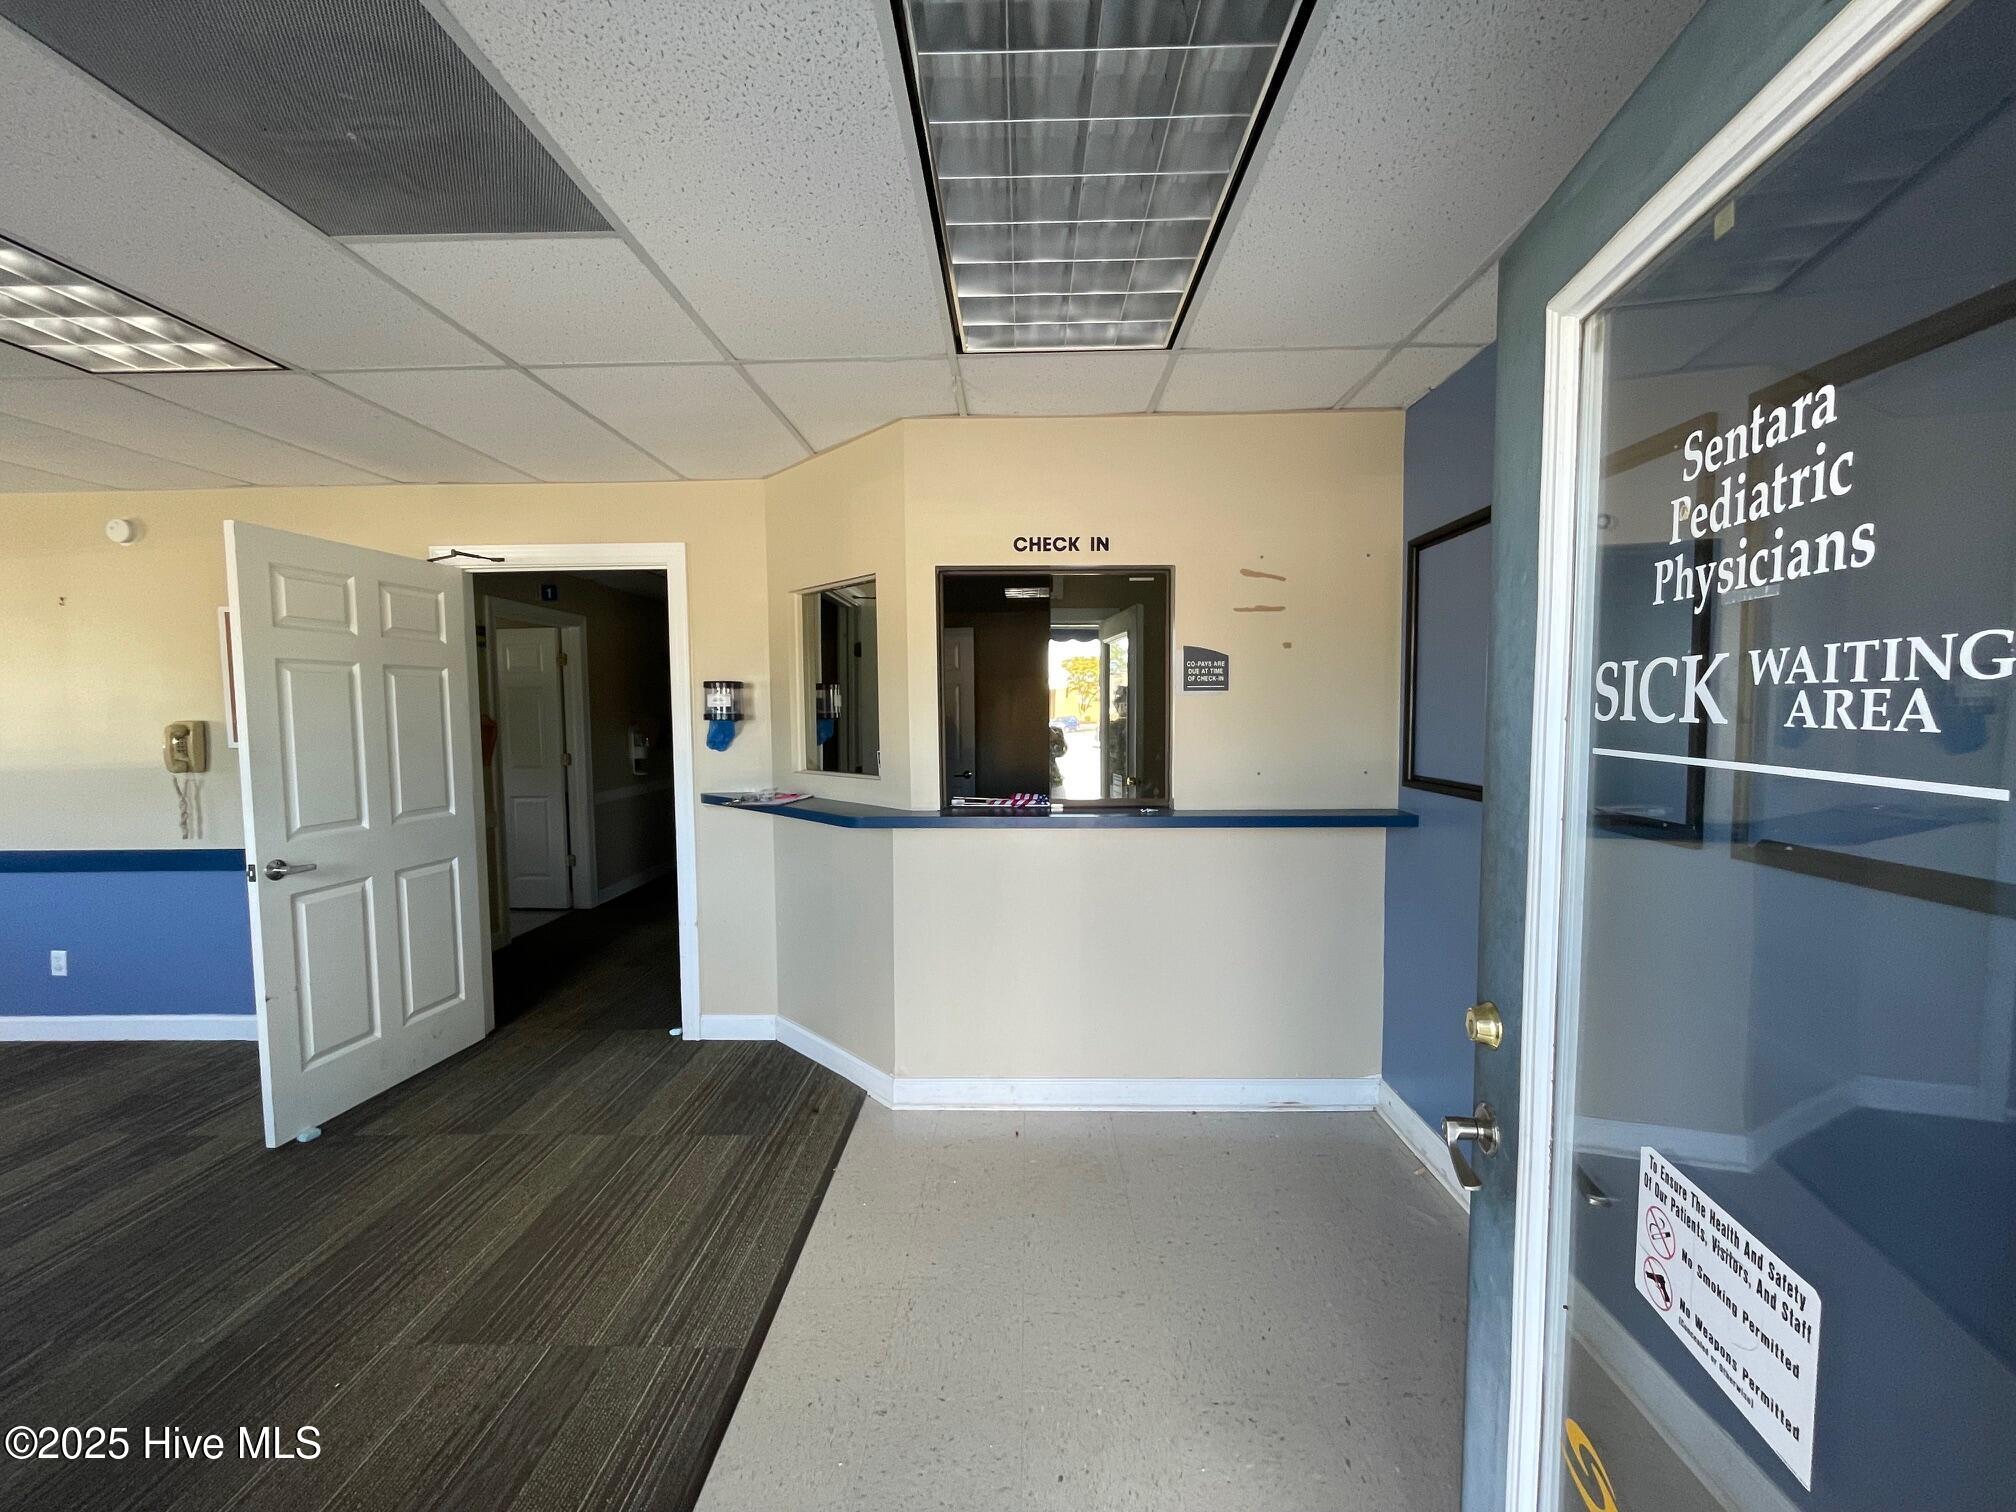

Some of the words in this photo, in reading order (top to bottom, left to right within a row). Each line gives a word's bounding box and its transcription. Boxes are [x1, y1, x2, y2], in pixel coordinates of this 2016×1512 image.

[1683, 384, 1837, 482] Sentara
[1013, 536, 1081, 552] CHECK
[1090, 536, 1110, 552] IN
[1668, 442, 1854, 546] Pediatric
[1652, 522, 1876, 614] Physicians
[1594, 652, 1729, 725] SICK
[1748, 629, 2016, 686] WAITING
[1784, 687, 1941, 733] AREA
[1643, 1171, 1652, 1191] Of
[1654, 1182, 1667, 1206] Our
[1670, 1197, 1708, 1247] Patients,
[1711, 1235, 1752, 1289] Visitors,
[1756, 1278, 1777, 1311] And
[1781, 1301, 1812, 1344] Staff
[1649, 1154, 1658, 1174] To
[1660, 1164, 1687, 1201] Ensure
[1691, 1191, 1706, 1218] The
[1709, 1208, 1740, 1250] Health
[1743, 1240, 1764, 1272] And
[1768, 1261, 1806, 1312] Safety
[1681, 1248, 1693, 1269] No
[1696, 1264, 1738, 1318] Smoking
[1742, 1309, 1800, 1379] Permitted
[1679, 1297, 1691, 1319] No
[1694, 1313, 1738, 1372] Weapons
[1742, 1366, 1800, 1442] Permitted
